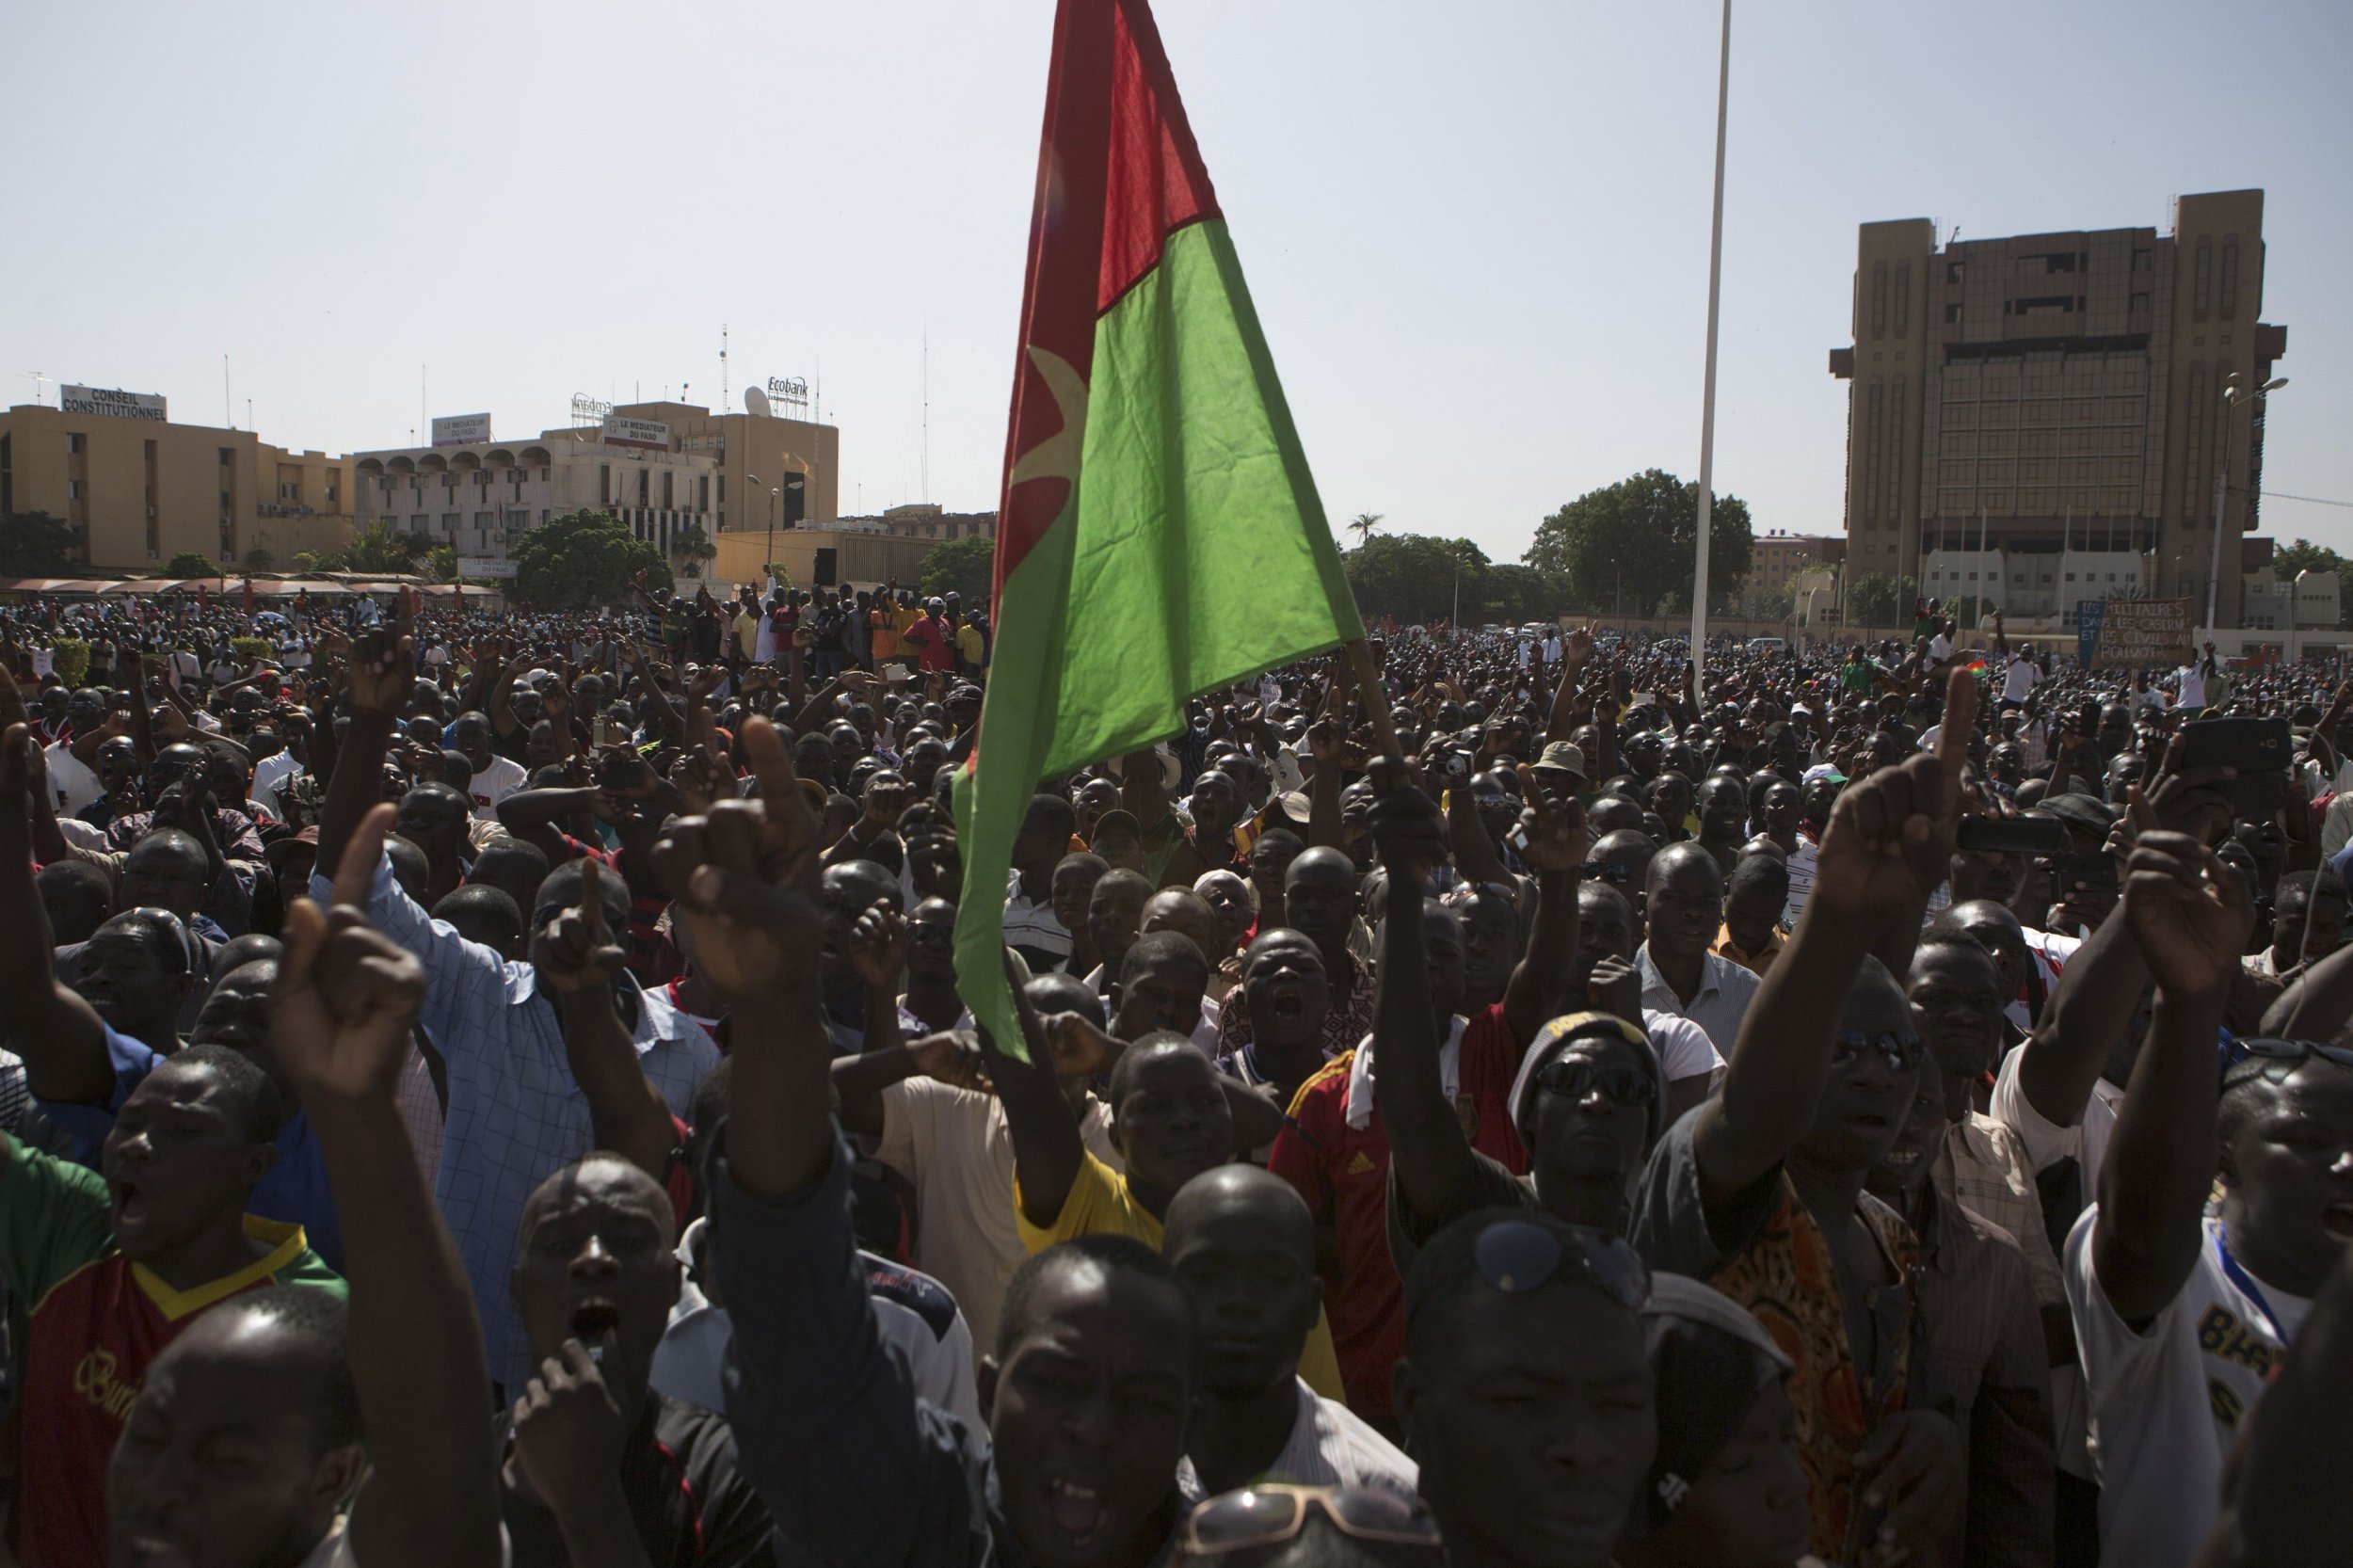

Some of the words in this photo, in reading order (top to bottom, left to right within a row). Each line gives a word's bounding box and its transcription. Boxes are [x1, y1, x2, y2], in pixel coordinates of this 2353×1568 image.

[769, 376, 808, 396] Ecobank
[91, 388, 139, 406] CONSEIL
[63, 398, 167, 421] CONSTITUTIONNEL
[620, 420, 628, 428] LE
[630, 421, 666, 433] MEDIATEUR
[640, 432, 657, 440] FASO
[2082, 602, 2099, 614] LES
[2105, 602, 2185, 616] MILITAIRES
[2117, 616, 2136, 629] LES
[2081, 630, 2096, 641] ET
[2100, 631, 2118, 644] LES
[2123, 631, 2169, 646] CIVILS
[2175, 632, 2191, 646] AU
[2101, 646, 2167, 659] POUVOIR
